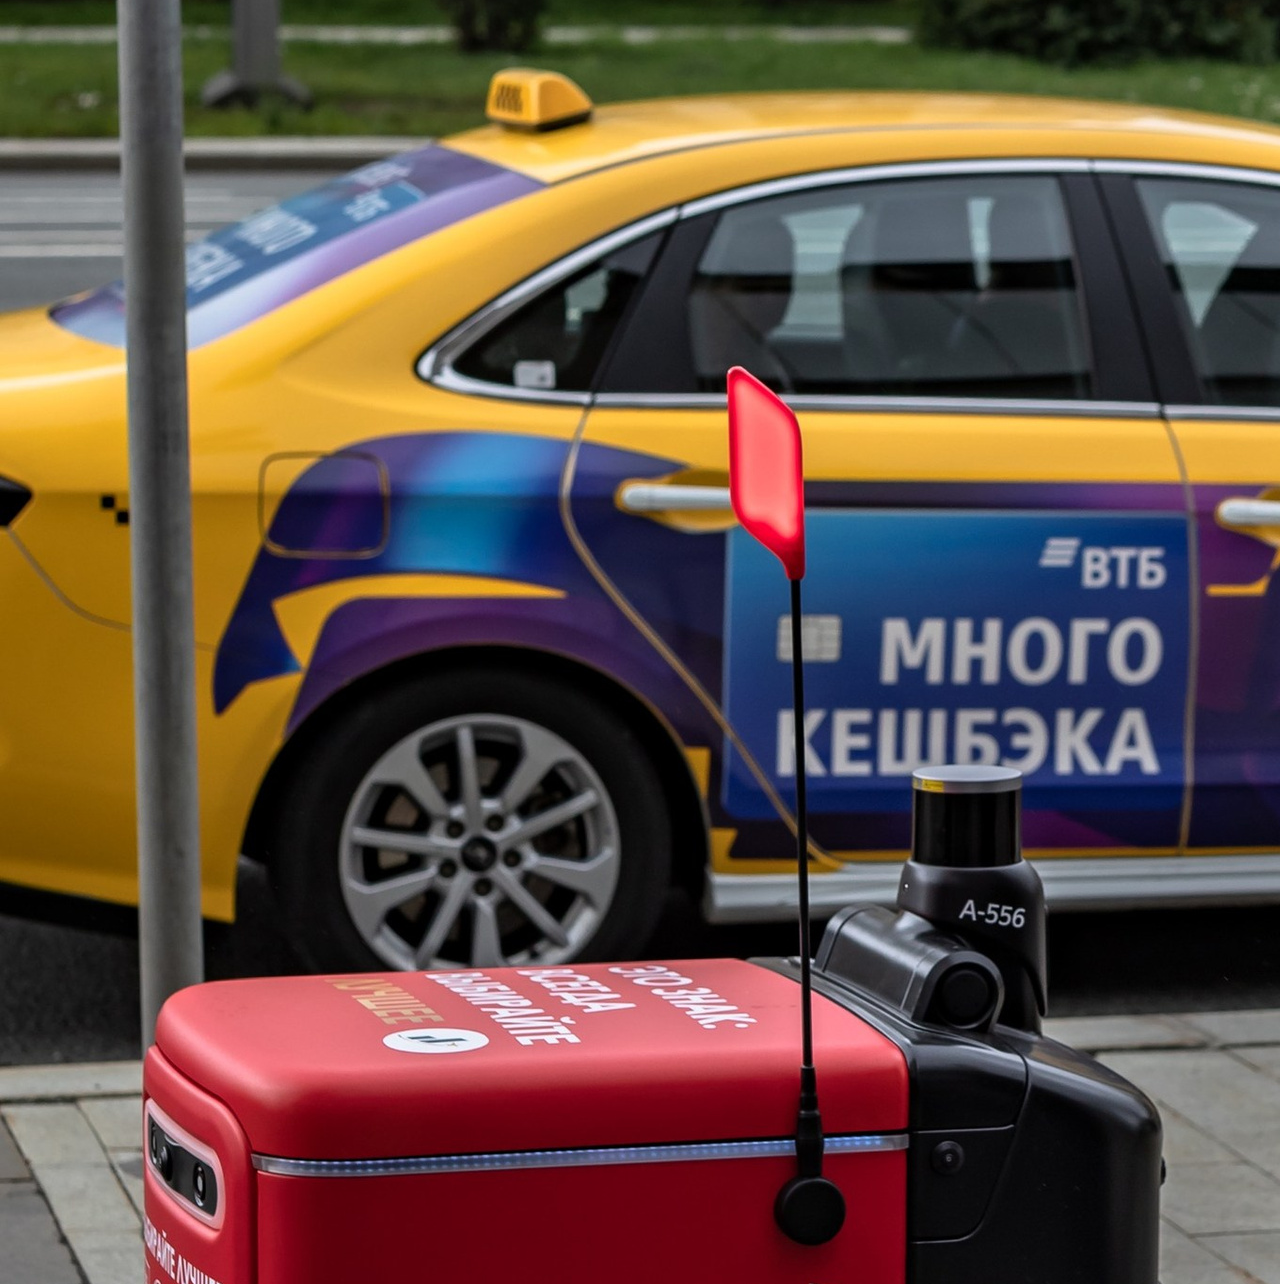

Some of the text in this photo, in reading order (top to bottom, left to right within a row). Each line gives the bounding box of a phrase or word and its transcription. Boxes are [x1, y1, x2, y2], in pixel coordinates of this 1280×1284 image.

[1080, 545, 1168, 589] ВТБ
[879, 615, 1164, 687] МНОГО
[775, 706, 1162, 778] КЕШБЭКА
[516, 968, 637, 1013] ВСЕГДА
[607, 965, 694, 987] ЭТО
[323, 977, 445, 1026] ЛУЧШЕЕ
[424, 971, 582, 1047] ВЫБИРАЙТЕ
